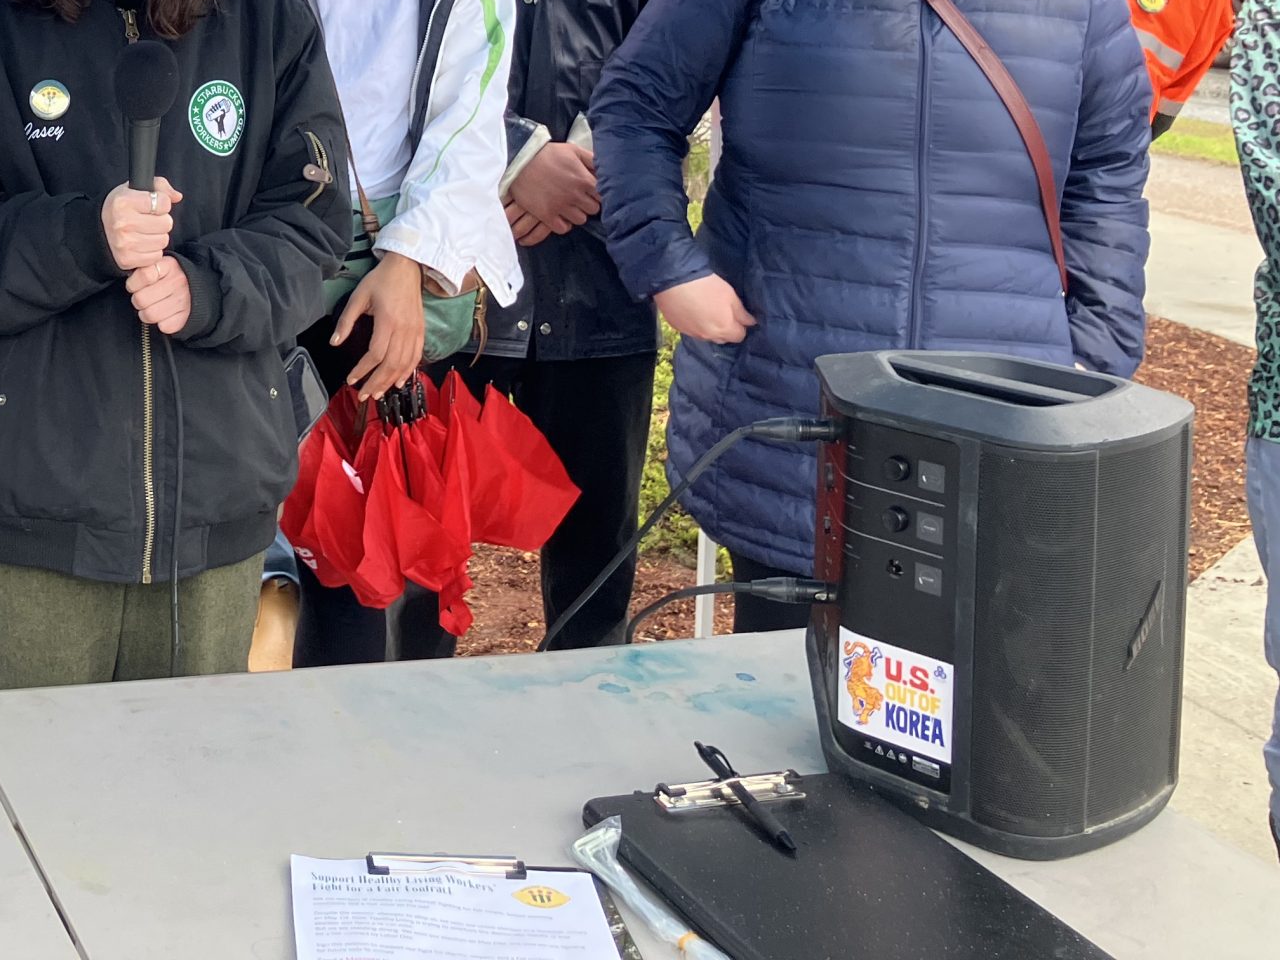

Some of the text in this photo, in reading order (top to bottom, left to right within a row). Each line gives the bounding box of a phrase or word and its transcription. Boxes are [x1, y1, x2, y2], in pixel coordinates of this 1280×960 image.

[197, 85, 241, 106] STARBUCKS
[192, 115, 224, 150] WORKERS
[885, 656, 935, 695] U.S.
[885, 682, 942, 715] OUT OF
[885, 701, 945, 748] KOREA
[310, 872, 354, 885] Support
[359, 875, 401, 885] Healthy
[406, 875, 442, 885] Living
[346, 884, 362, 892] for
